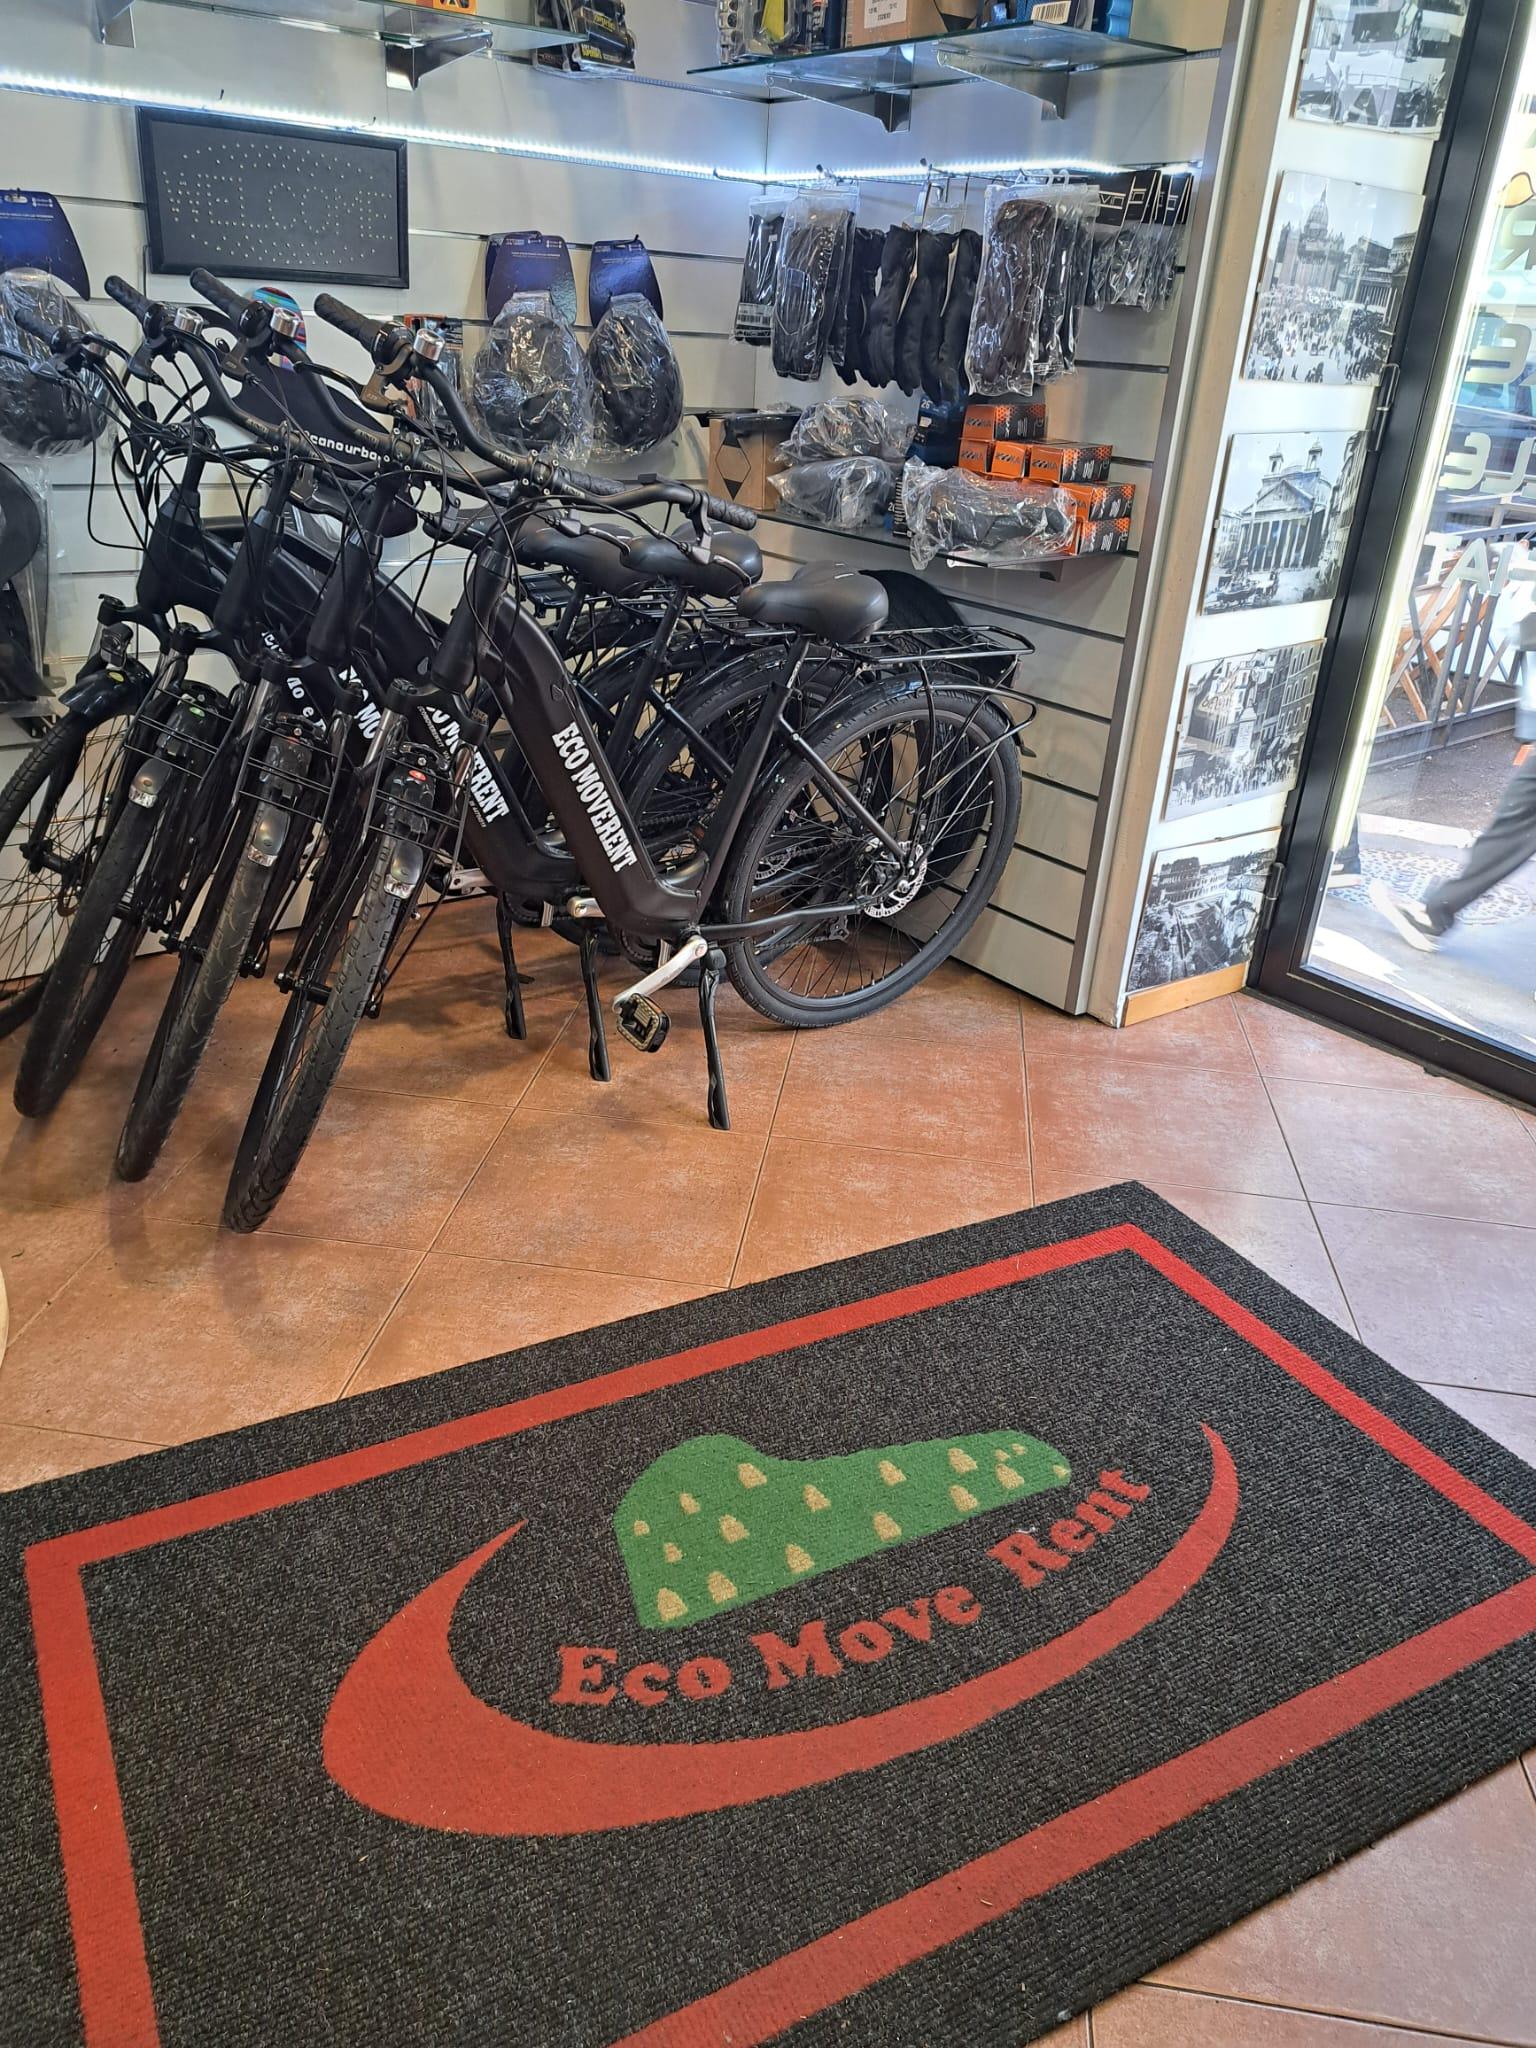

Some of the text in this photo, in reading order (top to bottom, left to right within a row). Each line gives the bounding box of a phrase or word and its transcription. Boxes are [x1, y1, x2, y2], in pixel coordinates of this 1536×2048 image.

[161, 171, 394, 240] WELCOME
[551, 721, 638, 873] ECO MOVERENT
[549, 1467, 1151, 1707] Eco Move Rent
